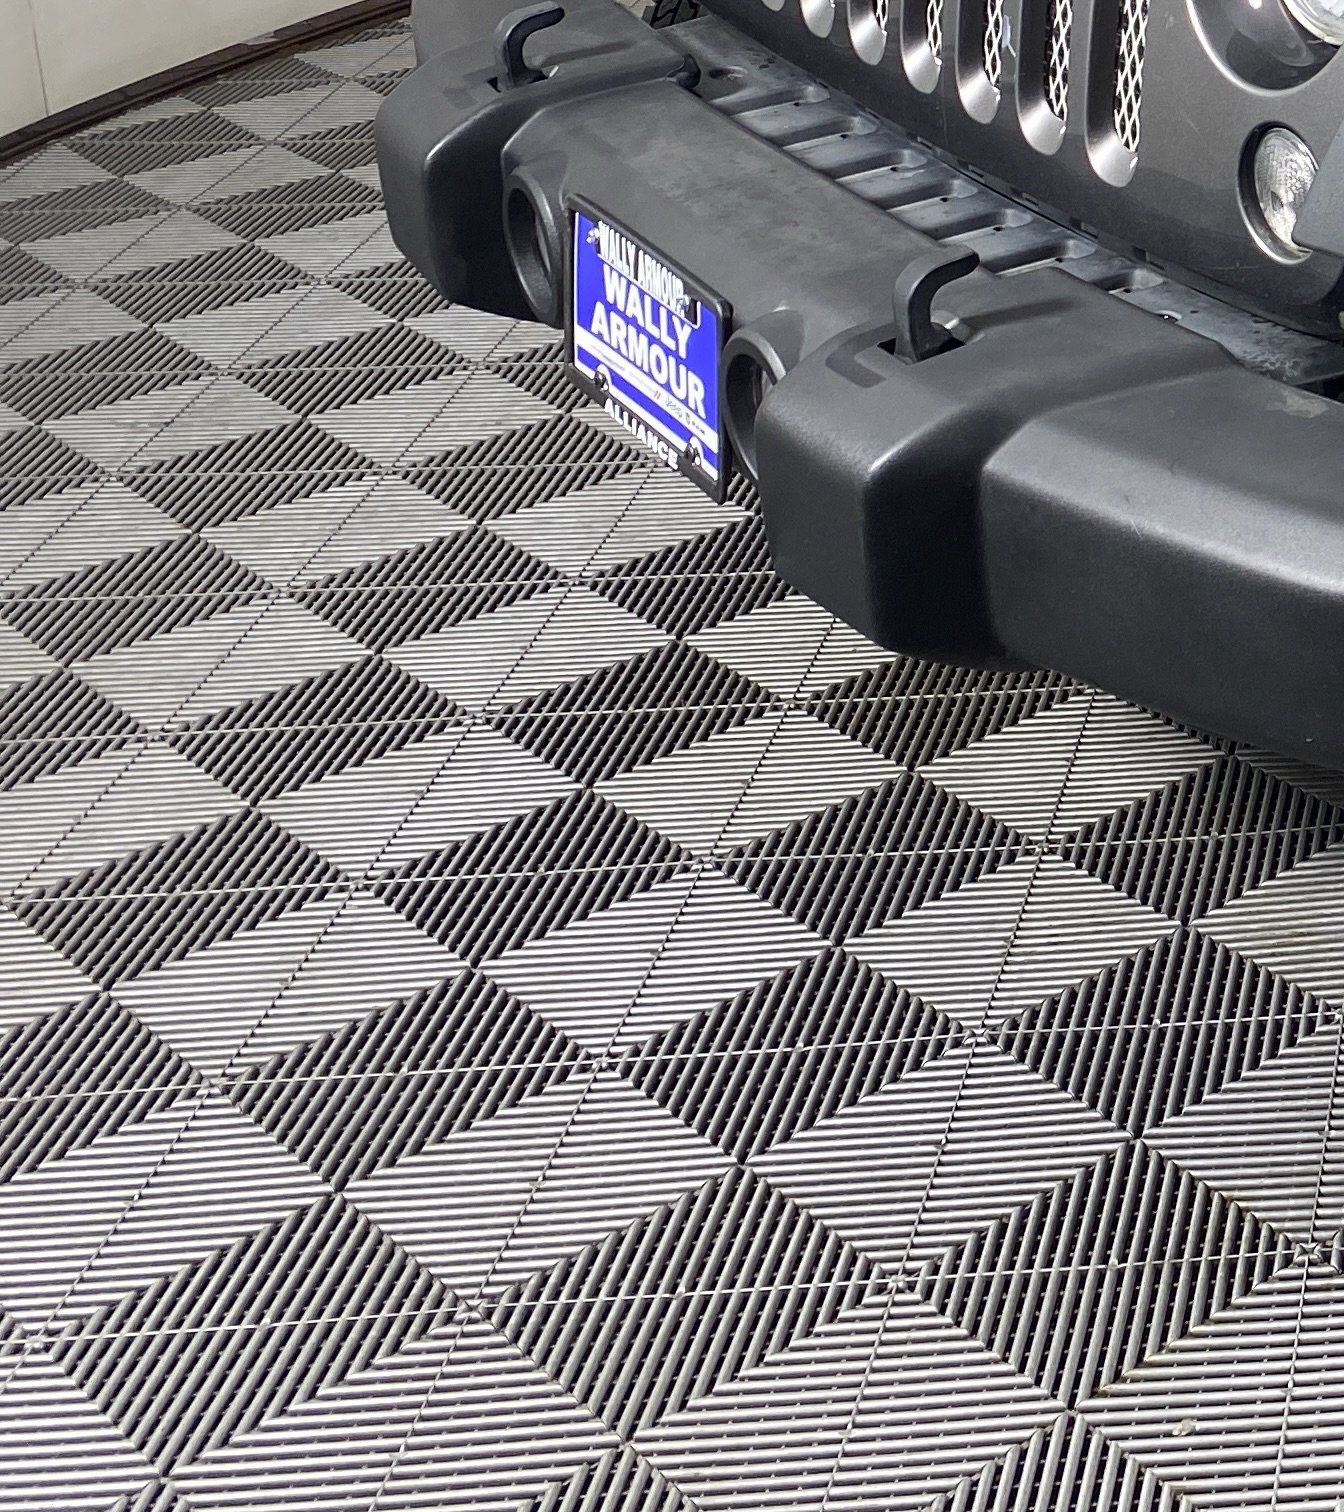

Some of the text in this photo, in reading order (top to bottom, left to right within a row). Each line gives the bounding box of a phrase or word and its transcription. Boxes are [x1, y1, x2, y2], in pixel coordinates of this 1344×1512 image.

[598, 220, 685, 312] WALLY ARMOUR
[603, 263, 692, 359] WALLY
[591, 301, 706, 419] ARMOUR
[604, 398, 678, 470] ALLIANCE
